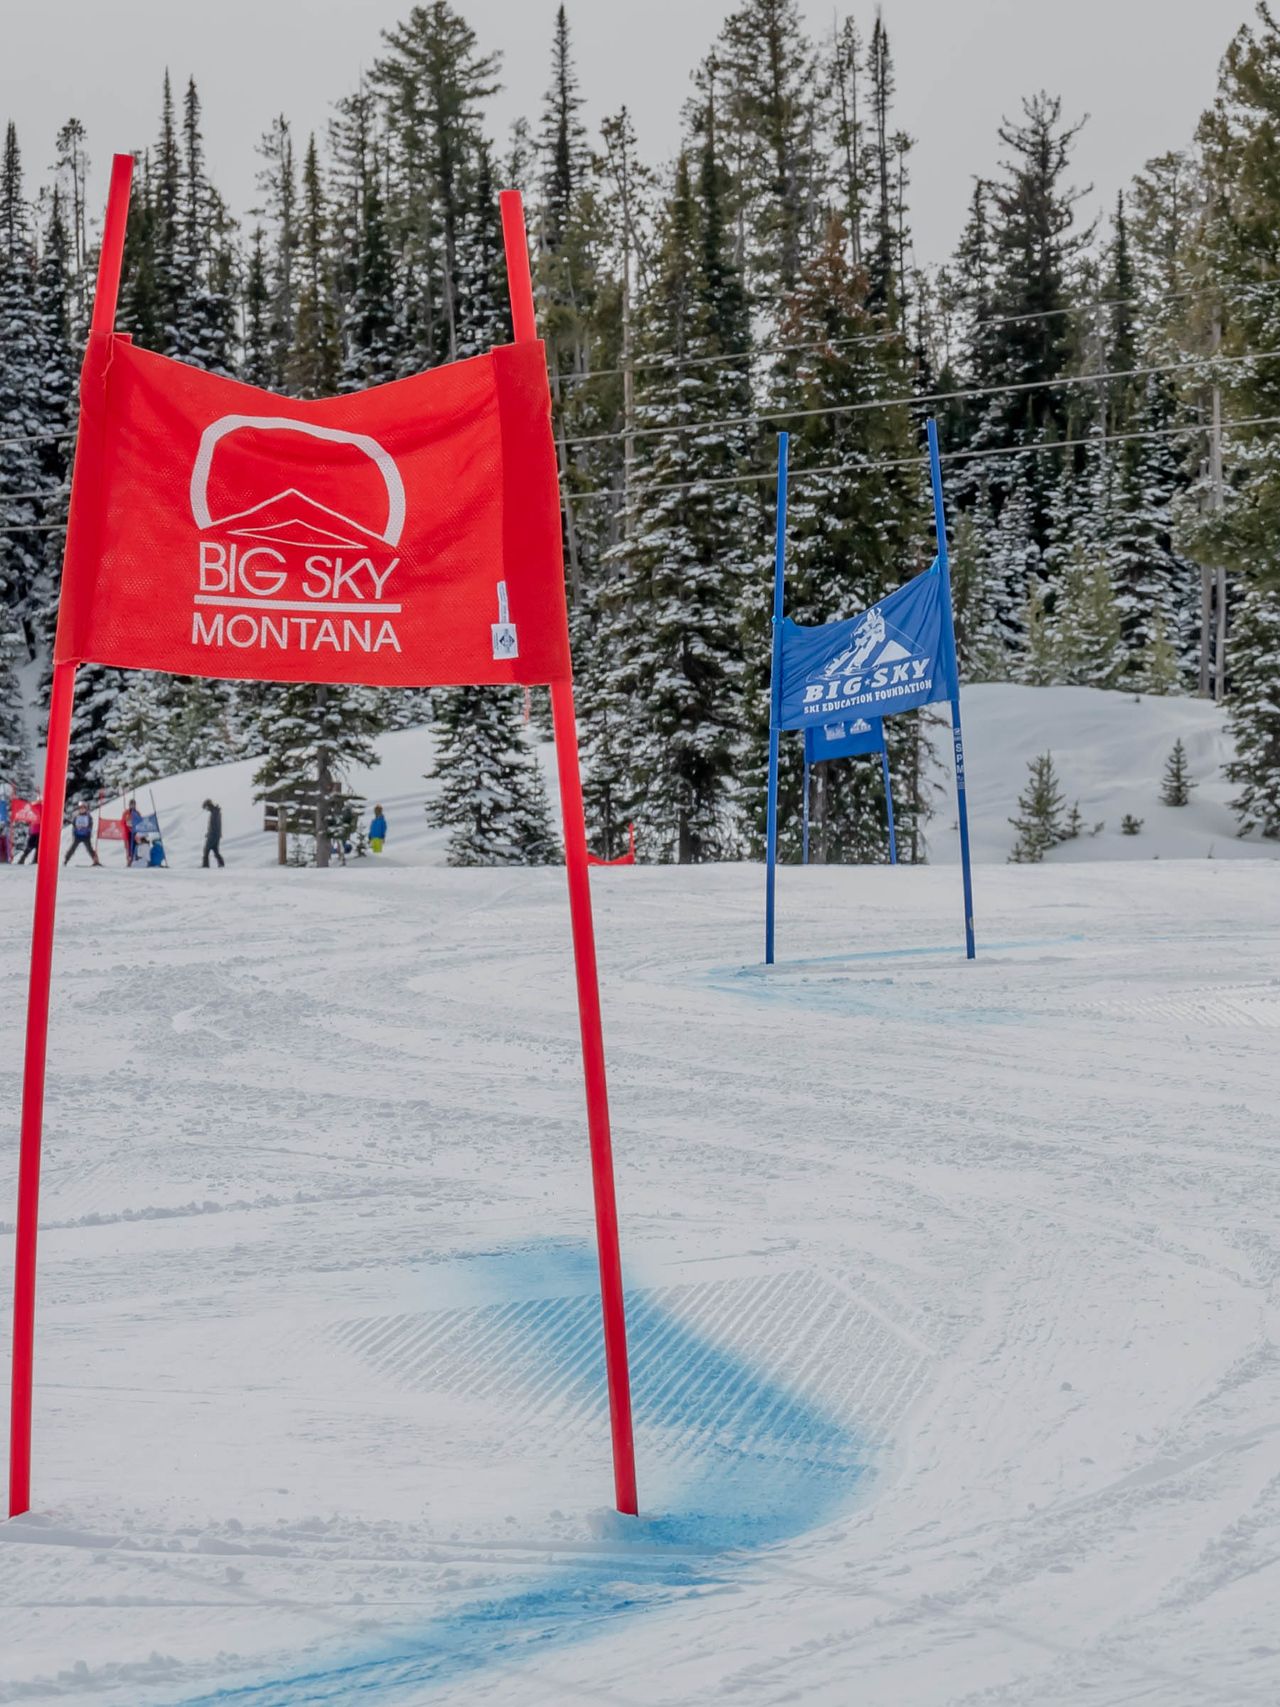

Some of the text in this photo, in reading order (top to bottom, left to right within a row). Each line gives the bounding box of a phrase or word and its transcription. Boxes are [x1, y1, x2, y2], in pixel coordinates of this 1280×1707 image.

[199, 541, 400, 600] BIG SKY
[191, 612, 402, 652] MONTANA
[803, 658, 930, 703] BIG SKY
[804, 679, 932, 714] SKI EDUCATION FOUNDATION
